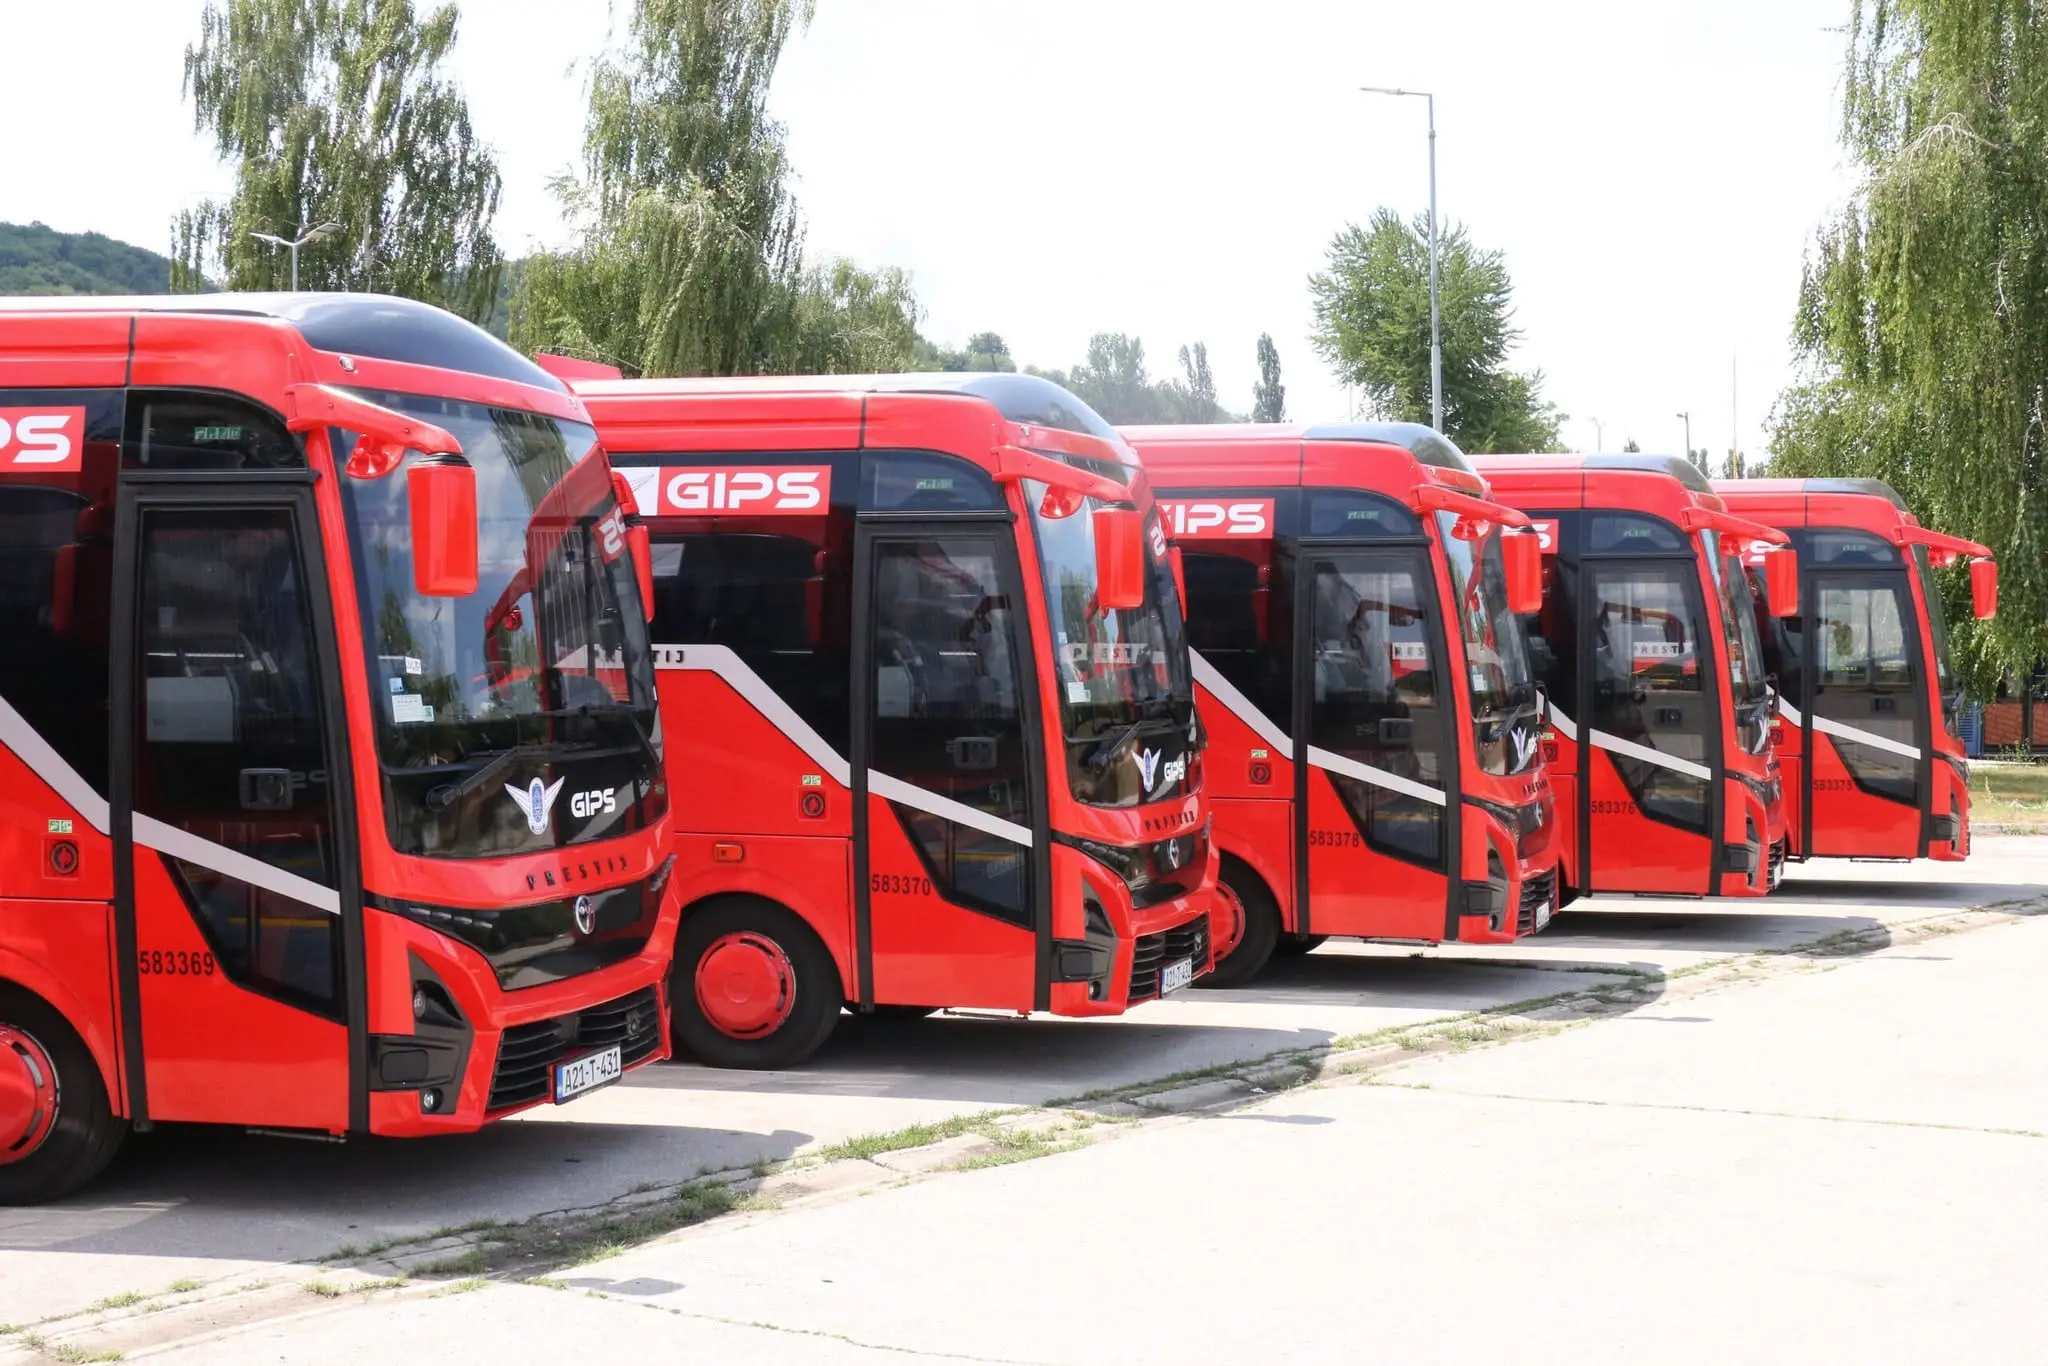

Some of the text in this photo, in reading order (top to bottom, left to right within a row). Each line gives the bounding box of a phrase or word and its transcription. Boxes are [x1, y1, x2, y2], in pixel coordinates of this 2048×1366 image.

[667, 472, 820, 509] GIPS
[571, 787, 616, 818] GIPS
[1591, 800, 1636, 815] 583376
[1309, 830, 1360, 848] 583378
[871, 874, 931, 896] 583370
[140, 950, 214, 976] 583369
[564, 1050, 619, 1093] A21-T-431
